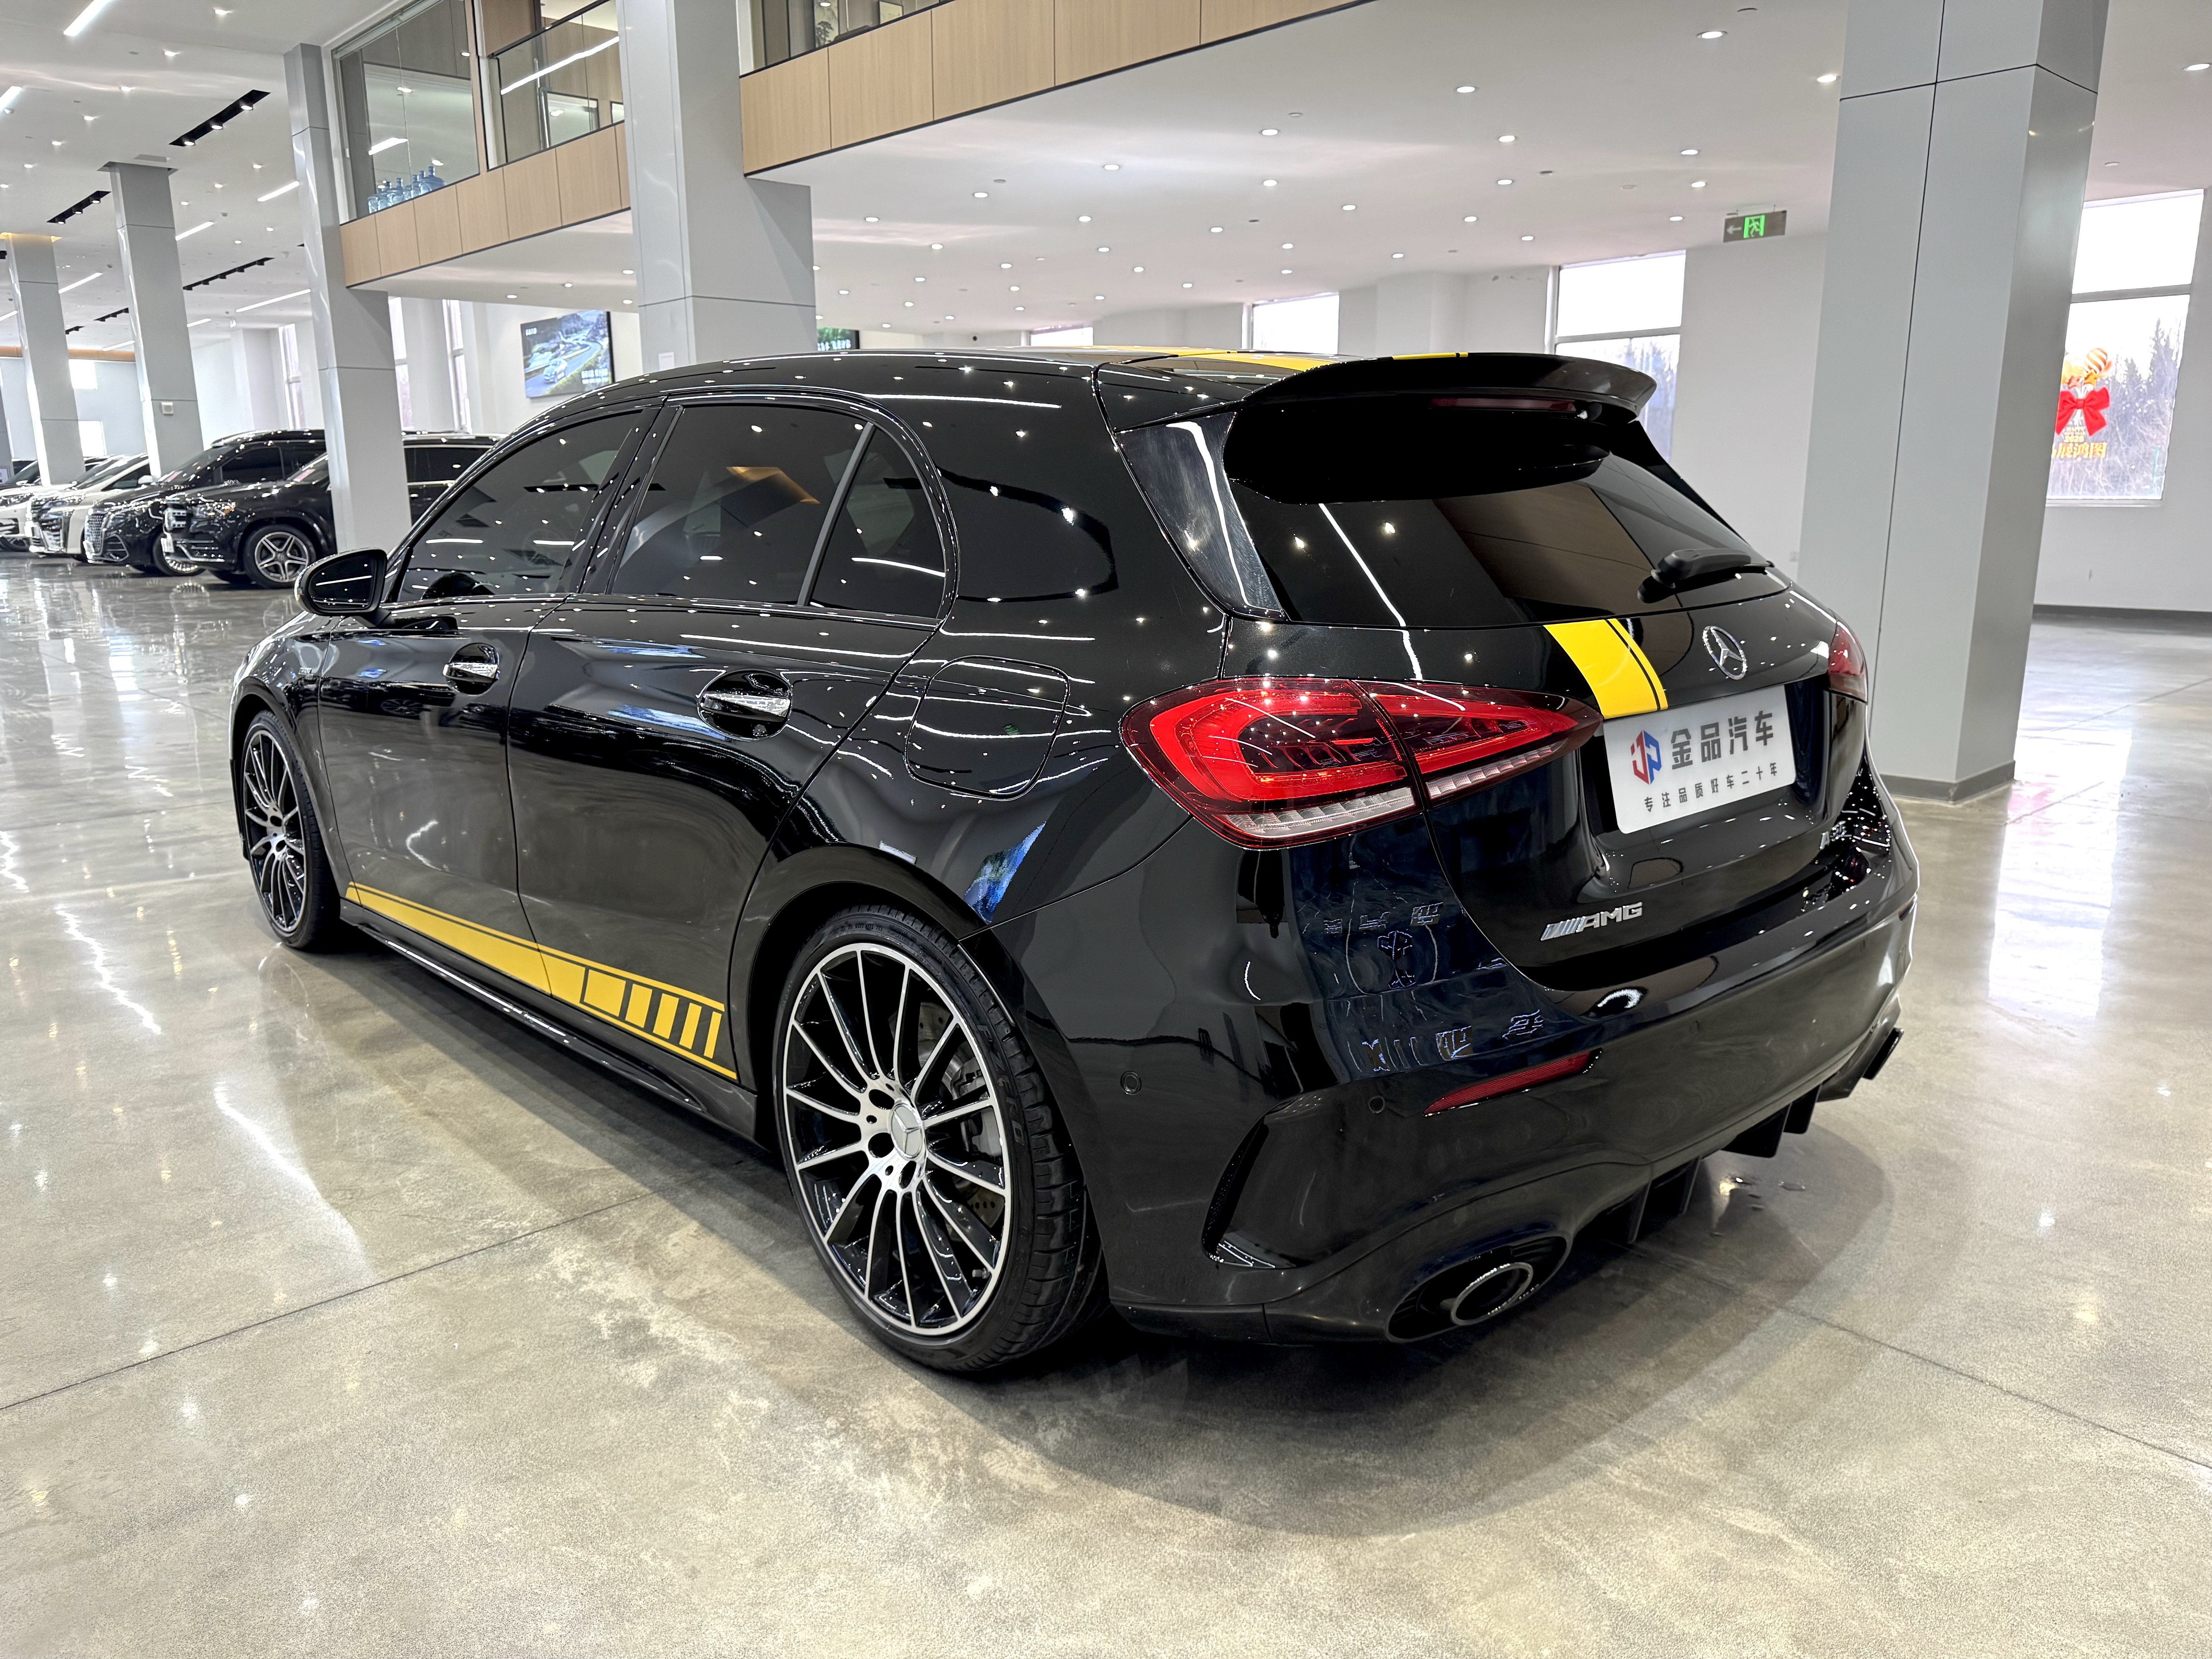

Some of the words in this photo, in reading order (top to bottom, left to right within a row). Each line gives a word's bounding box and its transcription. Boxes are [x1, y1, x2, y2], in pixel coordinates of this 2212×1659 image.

[1671, 710, 1774, 770] 金品汽车
[1644, 762, 1778, 812] 专注品质好车二十年
[1576, 902, 1643, 933] AMG
